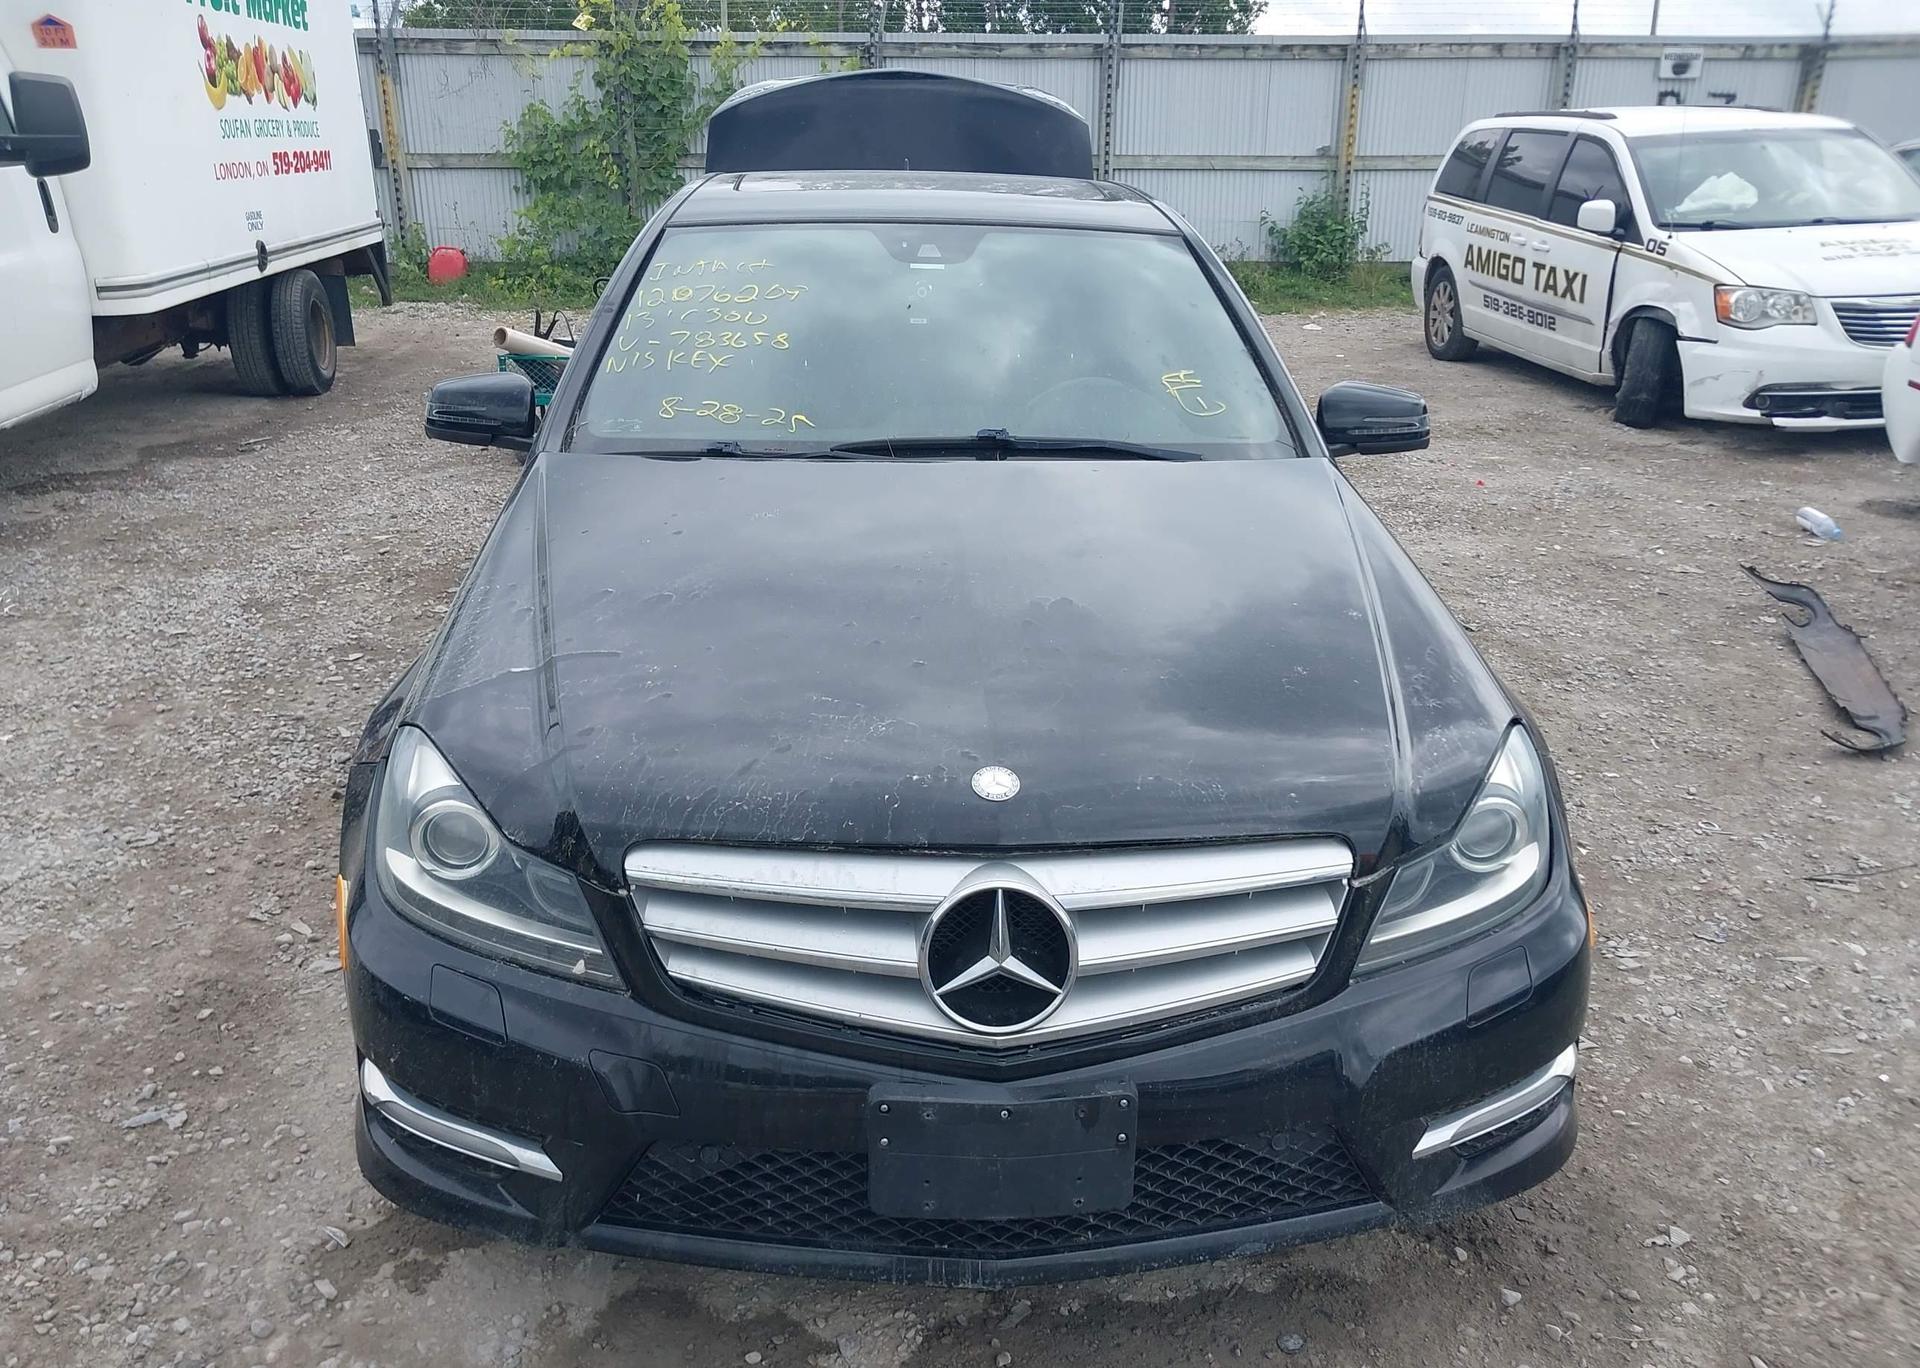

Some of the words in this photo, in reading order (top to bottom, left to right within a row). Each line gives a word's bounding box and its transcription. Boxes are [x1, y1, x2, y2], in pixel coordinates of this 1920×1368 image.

[220, 118, 252, 139] SOUFAN
[254, 118, 285, 138] GROCERY
[287, 120, 292, 137] &
[292, 120, 320, 138] PRODUCE
[213, 160, 256, 181] LONDON,
[256, 161, 269, 177] ON
[248, 221, 264, 232] ONLY
[1466, 221, 1512, 243] LEAMINGTON
[1645, 238, 1669, 257] 05
[1464, 243, 1526, 286] AMIGO
[1532, 261, 1588, 304] TAXI
[1483, 294, 1556, 331] 519-326-9012
